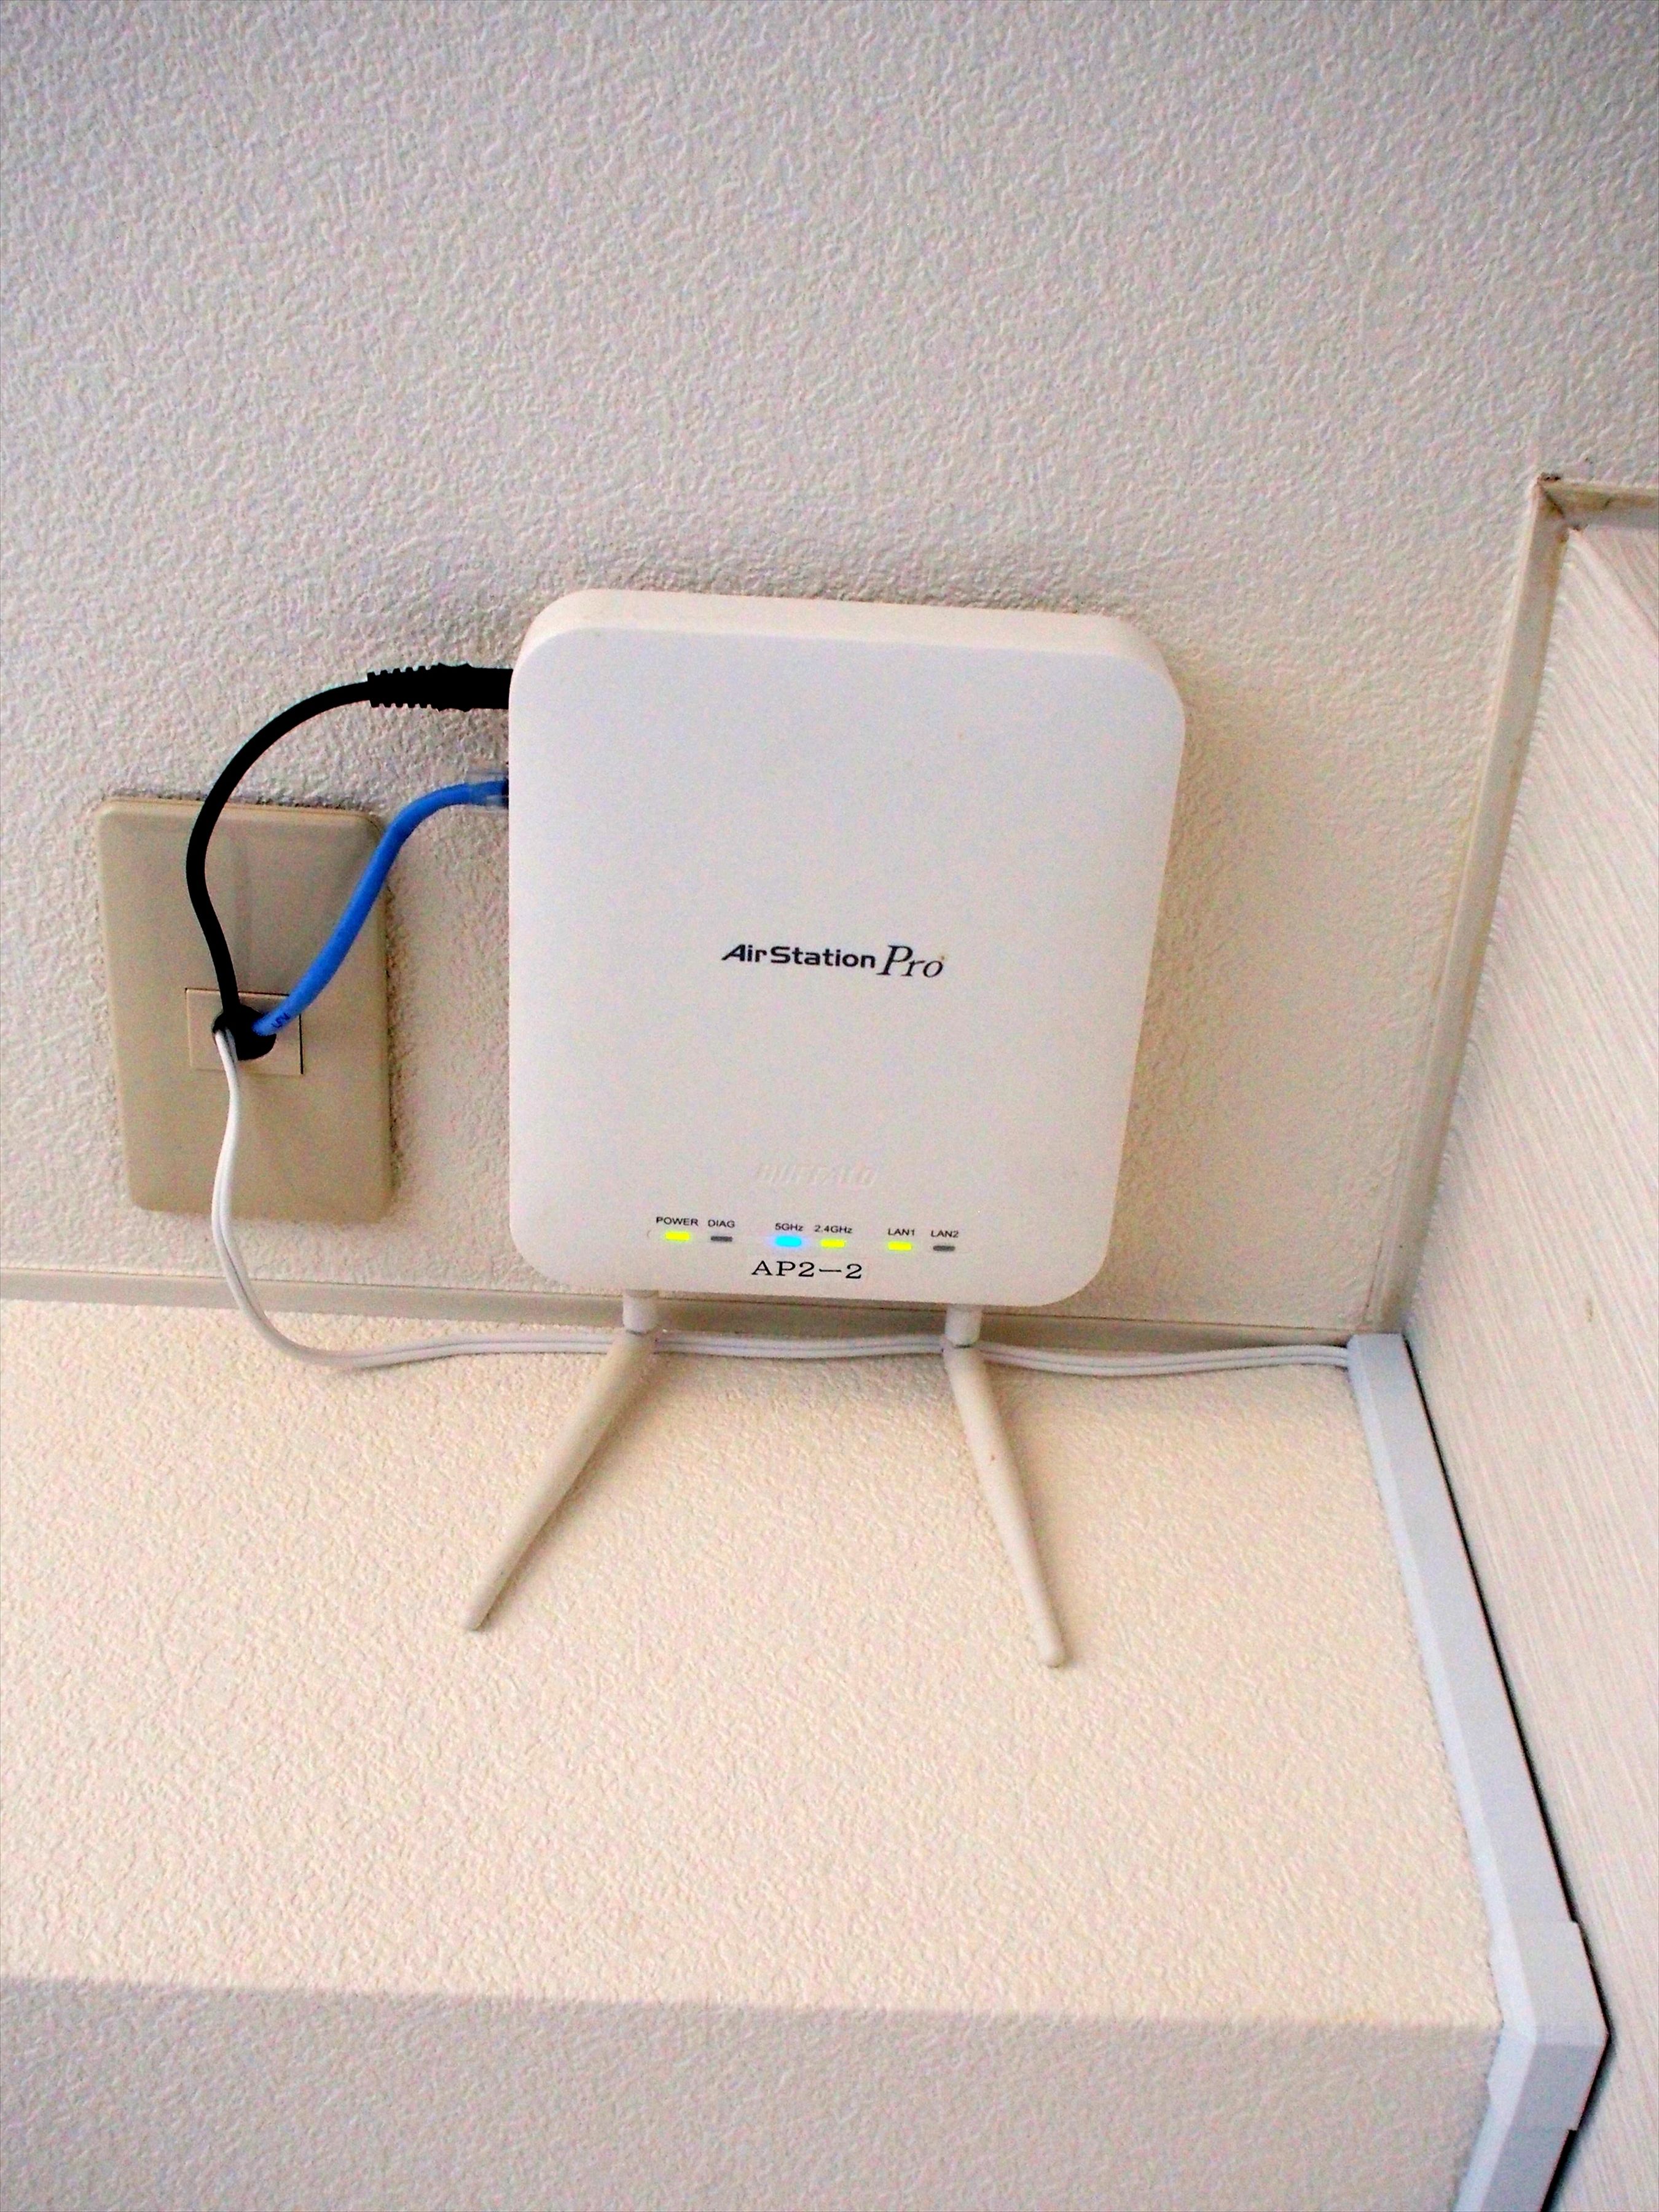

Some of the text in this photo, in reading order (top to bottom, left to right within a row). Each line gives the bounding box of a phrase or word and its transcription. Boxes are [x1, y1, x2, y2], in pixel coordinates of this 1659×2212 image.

[721, 943, 944, 978] AirStation Pro
[656, 1216, 959, 1239] POWER DIAG 5GHz 2.4GHz LAN1 LAN2
[750, 1260, 863, 1280] AP2-2
